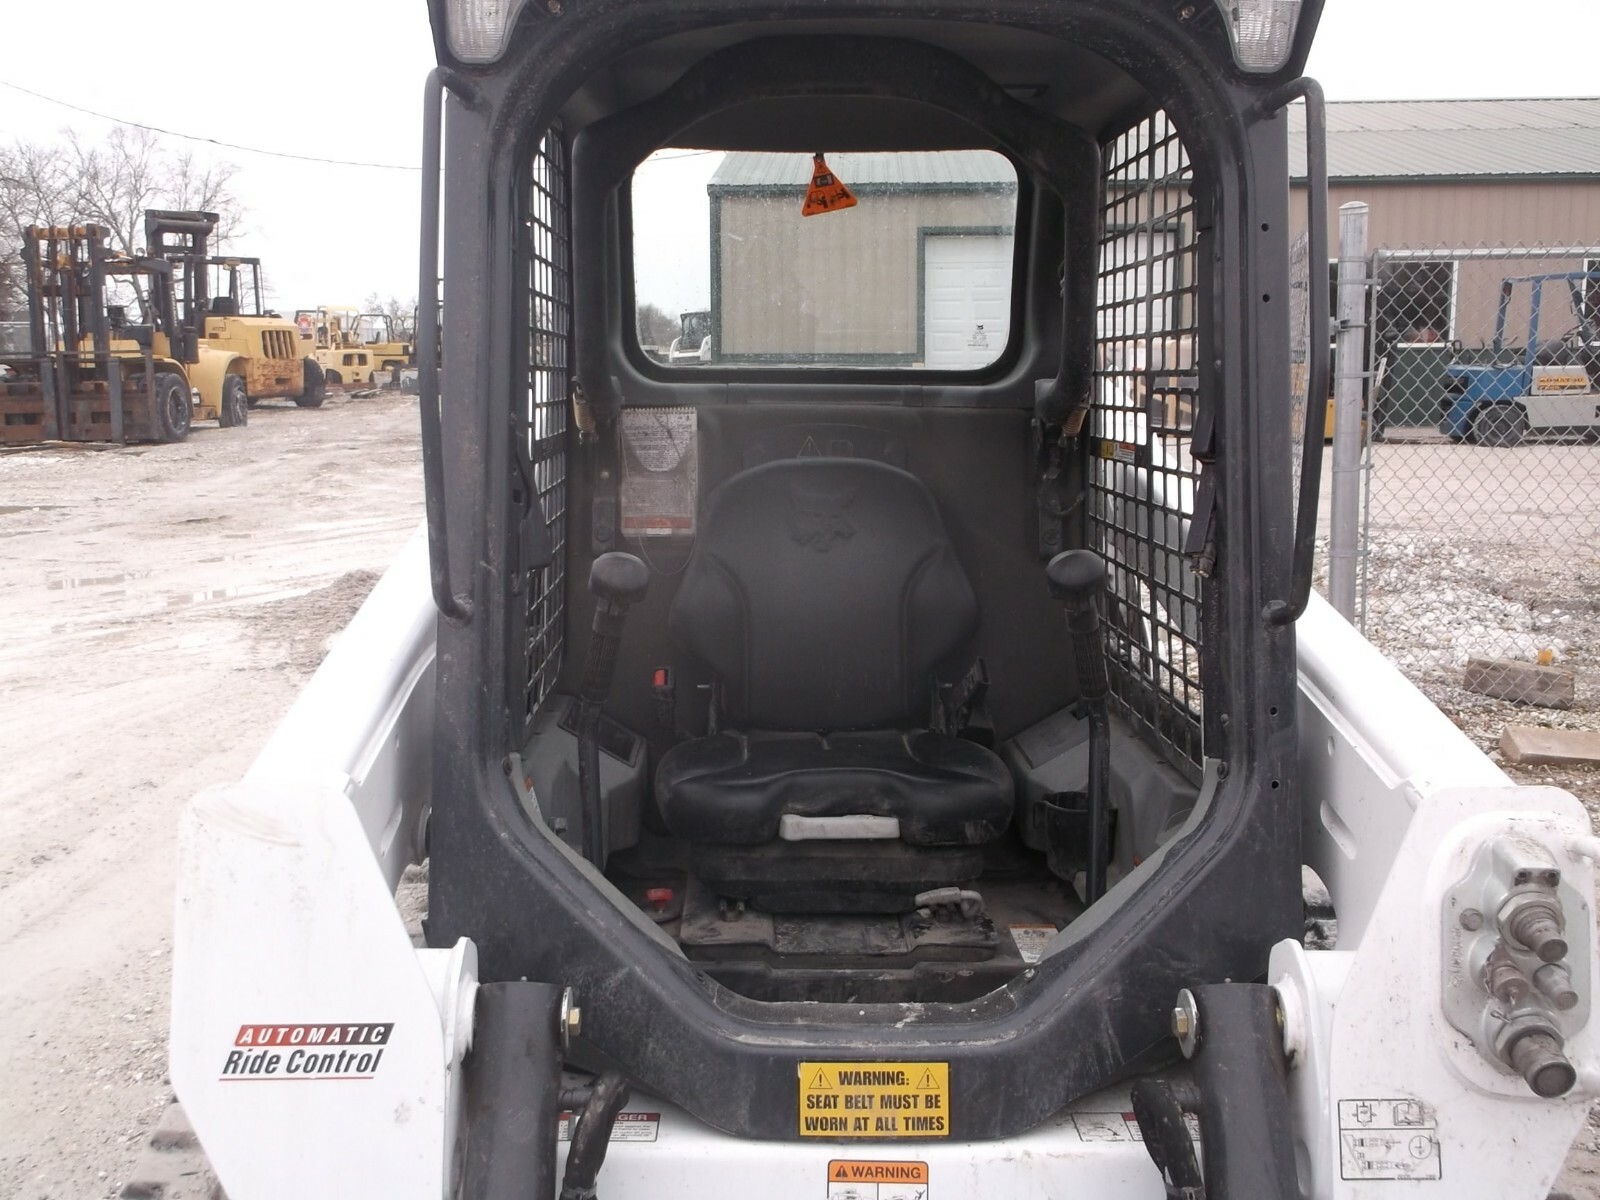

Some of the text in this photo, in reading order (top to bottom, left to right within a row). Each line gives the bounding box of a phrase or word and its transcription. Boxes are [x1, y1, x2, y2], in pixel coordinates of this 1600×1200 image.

[239, 1026, 385, 1044] AUTOMATIC
[222, 1048, 384, 1075] Ride Control
[838, 1070, 910, 1086] WARNING:
[806, 1094, 941, 1109] SEAT BELT MUST BE
[805, 1116, 945, 1131] WORN AT ALL TIMES
[851, 1165, 921, 1179] WARNING
